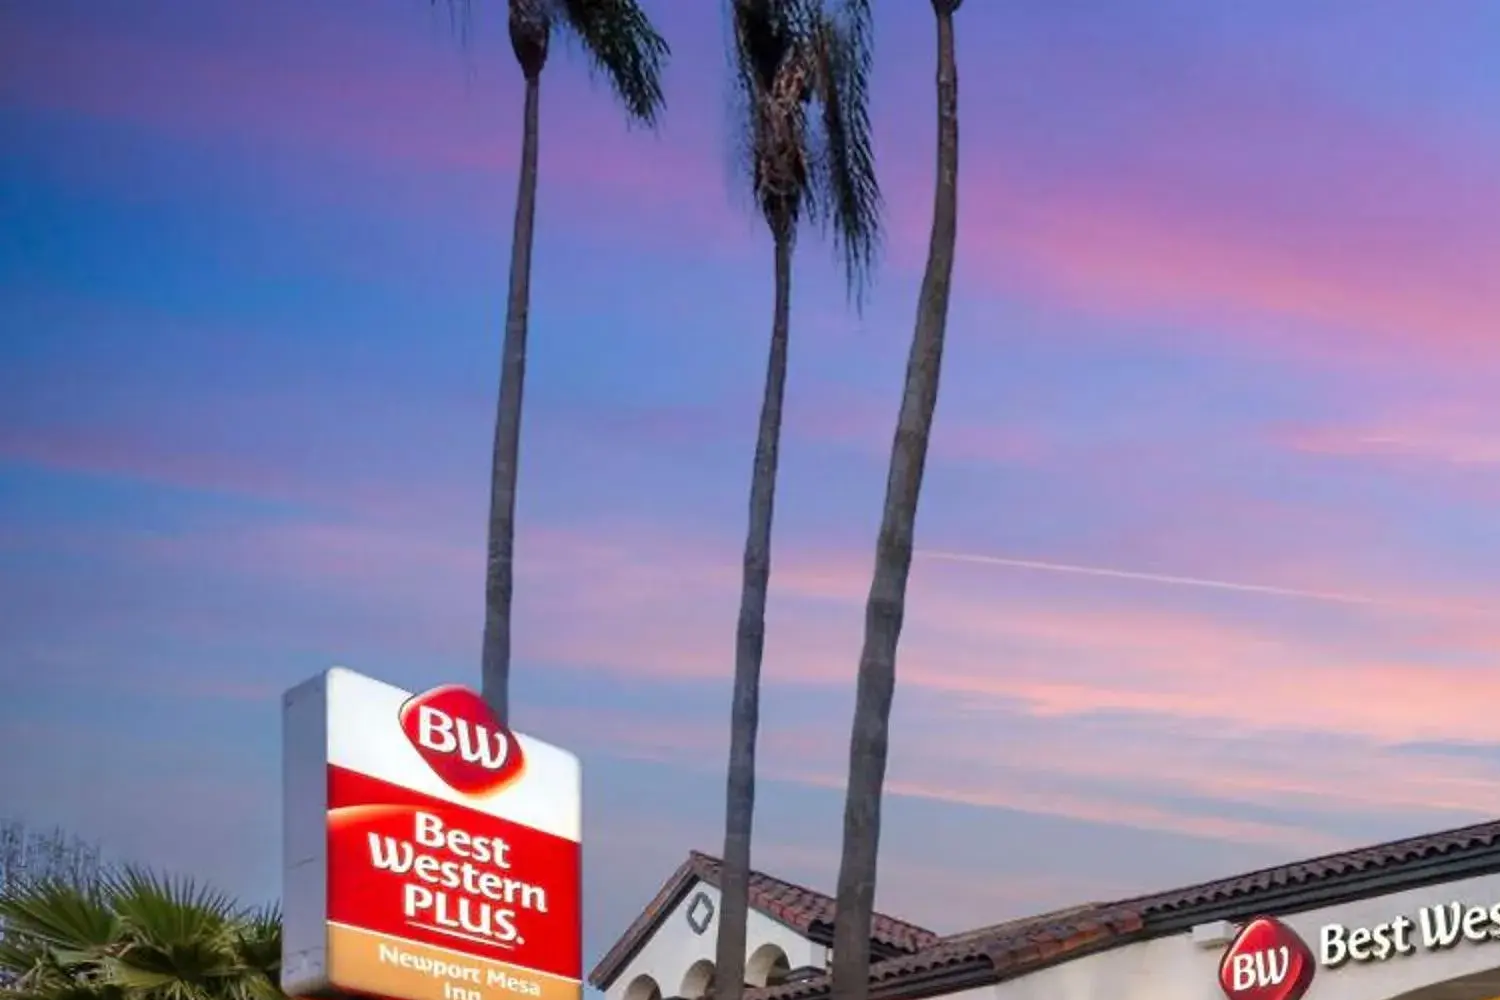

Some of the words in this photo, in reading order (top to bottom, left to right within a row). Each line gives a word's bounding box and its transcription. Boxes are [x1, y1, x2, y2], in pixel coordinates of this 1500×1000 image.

[418, 705, 507, 770] BW
[415, 811, 511, 868] Best
[368, 832, 548, 912] Western
[1319, 913, 1410, 966] Best
[379, 943, 481, 984] Newport
[486, 969, 542, 997] Mesa
[1233, 946, 1289, 992] BW
